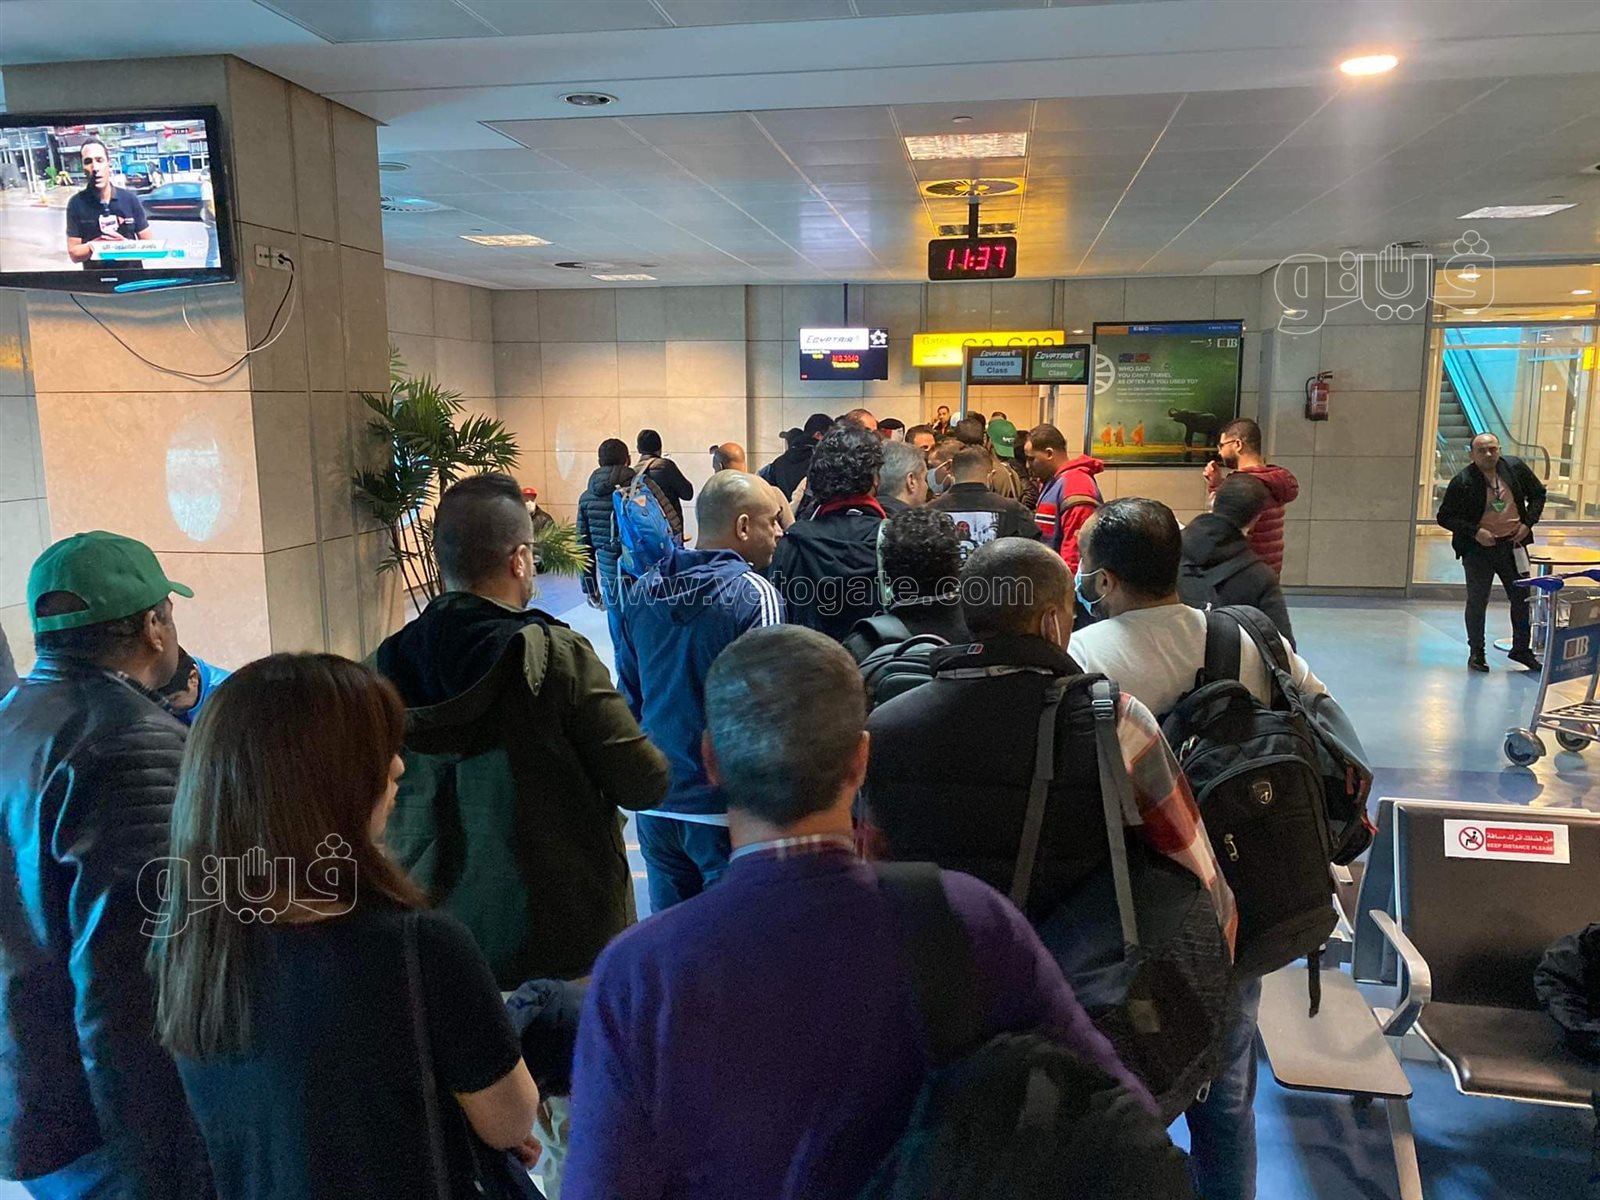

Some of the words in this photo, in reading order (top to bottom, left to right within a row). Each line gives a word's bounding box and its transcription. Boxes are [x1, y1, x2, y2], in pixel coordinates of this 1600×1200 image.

[947, 245, 1007, 270] 11:37
[1034, 351, 1074, 360] EGYPTAIR
[1041, 361, 1073, 369] Economy
